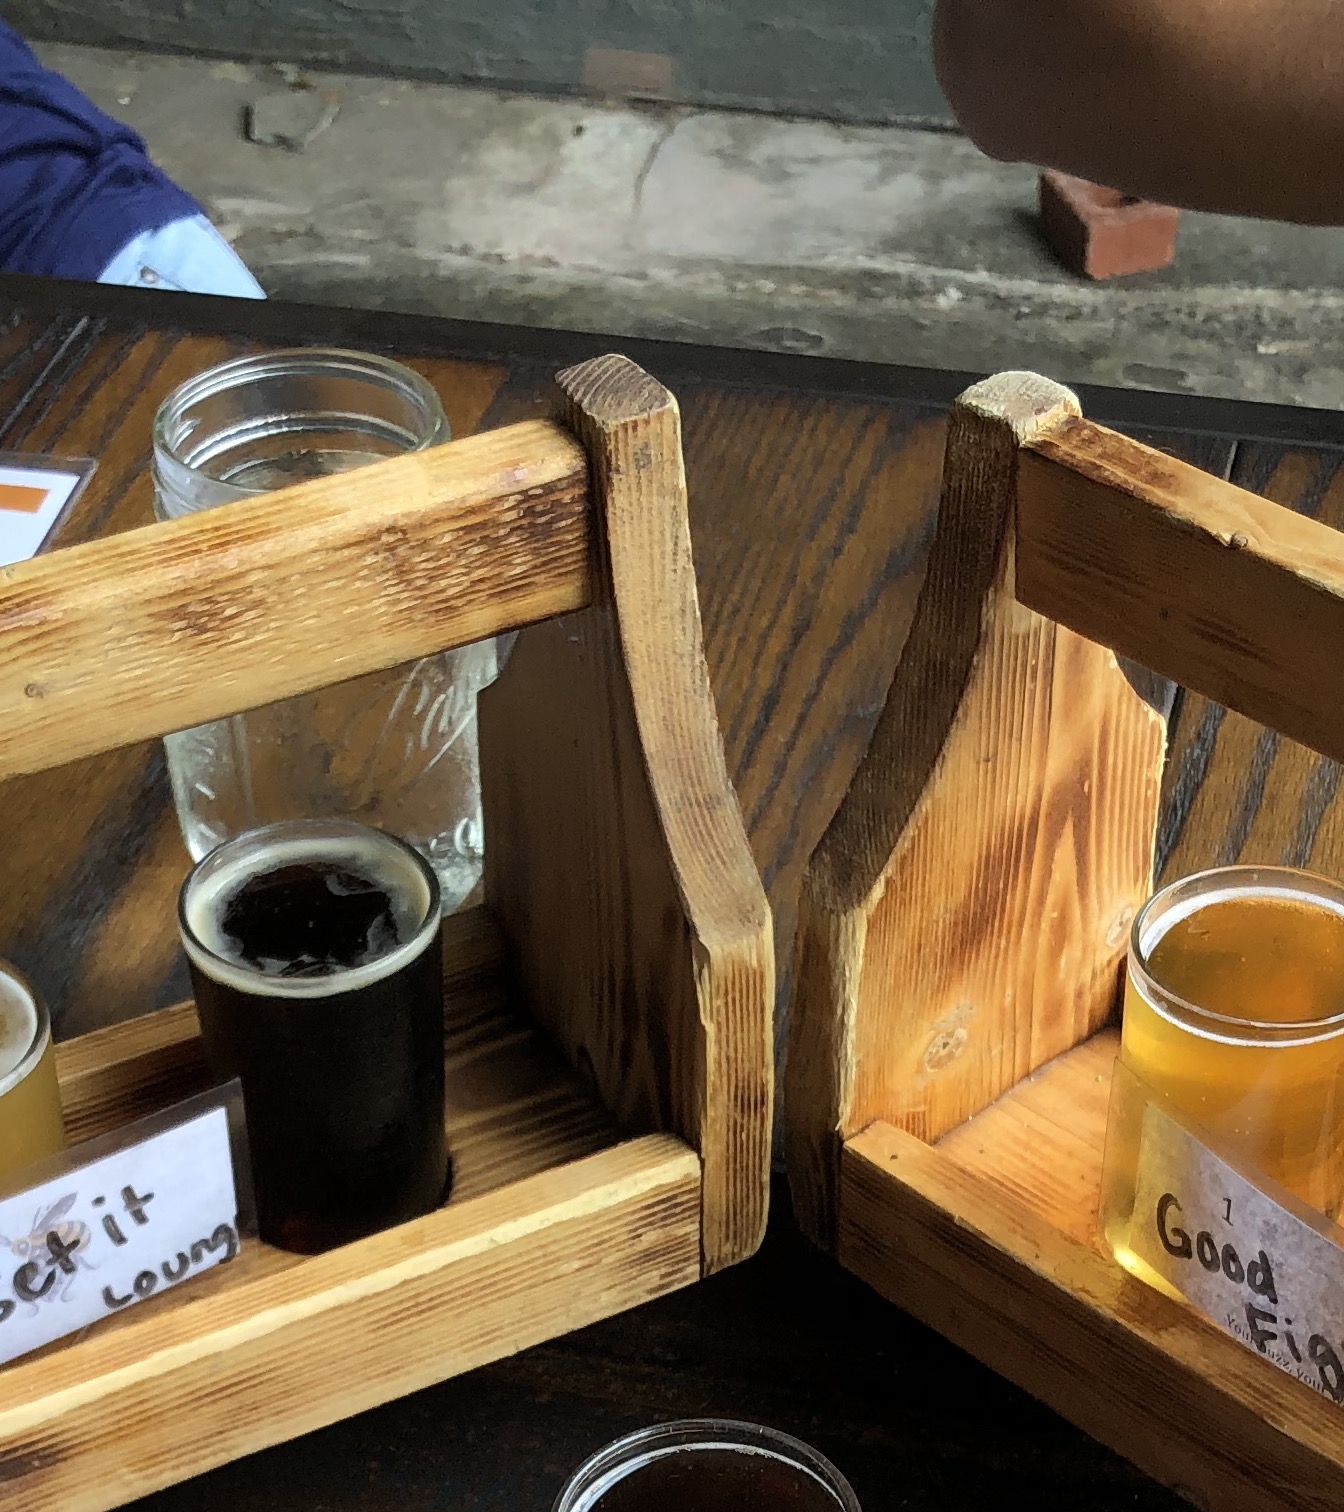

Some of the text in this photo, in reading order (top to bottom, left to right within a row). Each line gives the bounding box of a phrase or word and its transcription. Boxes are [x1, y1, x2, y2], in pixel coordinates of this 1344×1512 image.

[91, 1185, 154, 1247] it
[1222, 1197, 1233, 1227] 1
[1157, 1192, 1278, 1305] Good
